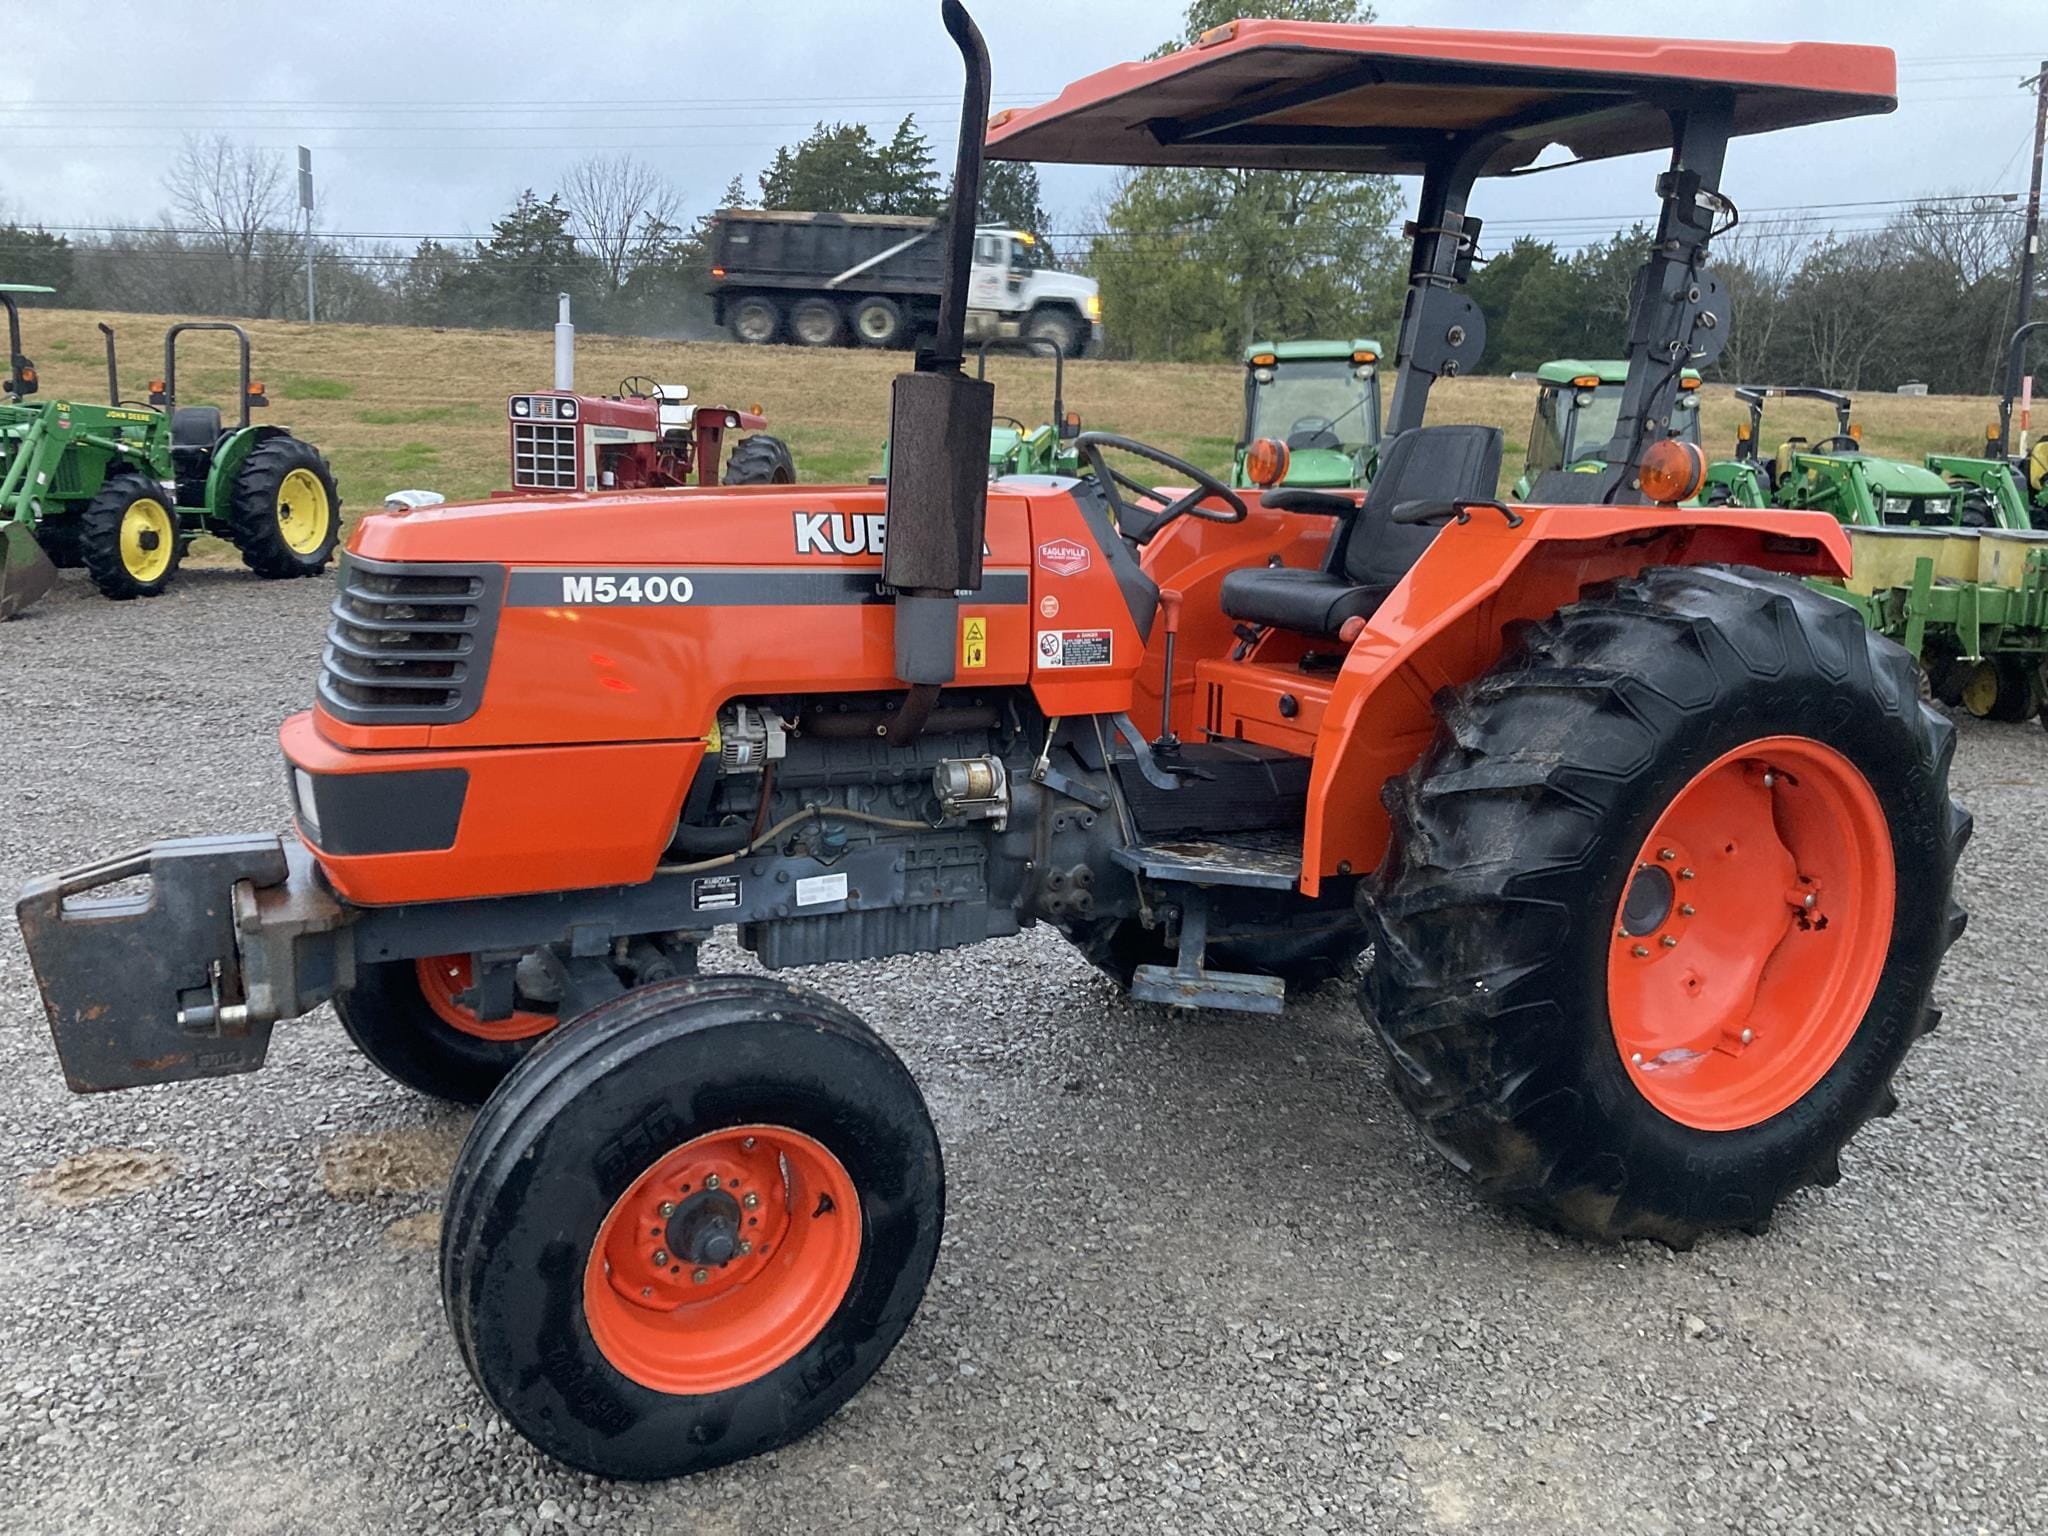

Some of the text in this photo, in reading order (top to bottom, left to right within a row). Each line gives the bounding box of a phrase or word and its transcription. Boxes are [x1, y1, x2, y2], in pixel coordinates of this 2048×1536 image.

[106, 411, 150, 421] JOHN DEERE
[1042, 547, 1086, 557] EAGLEVILLE
[562, 576, 693, 603] M5400
